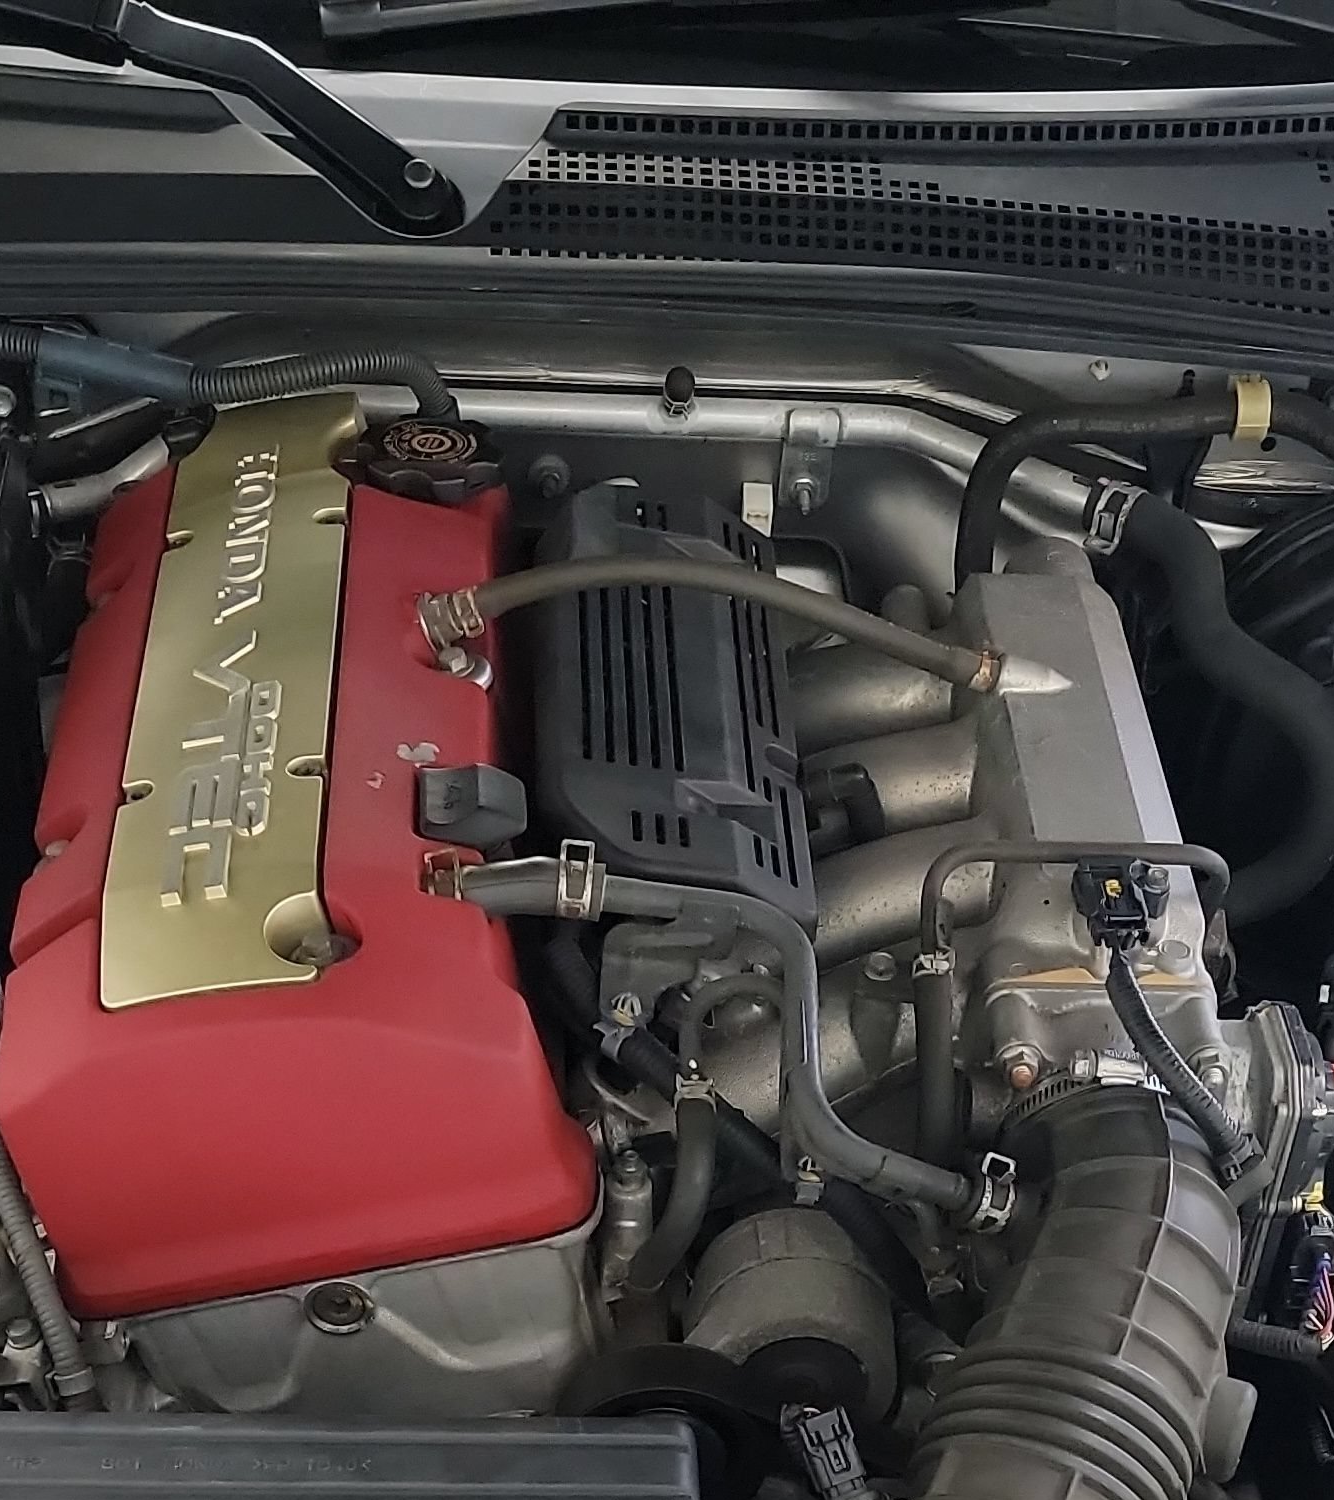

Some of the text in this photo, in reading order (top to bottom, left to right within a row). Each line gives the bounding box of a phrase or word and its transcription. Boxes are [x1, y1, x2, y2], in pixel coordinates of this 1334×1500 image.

[214, 444, 280, 625] HONDA
[160, 628, 257, 907] VTEC
[235, 679, 282, 837] DOHC
